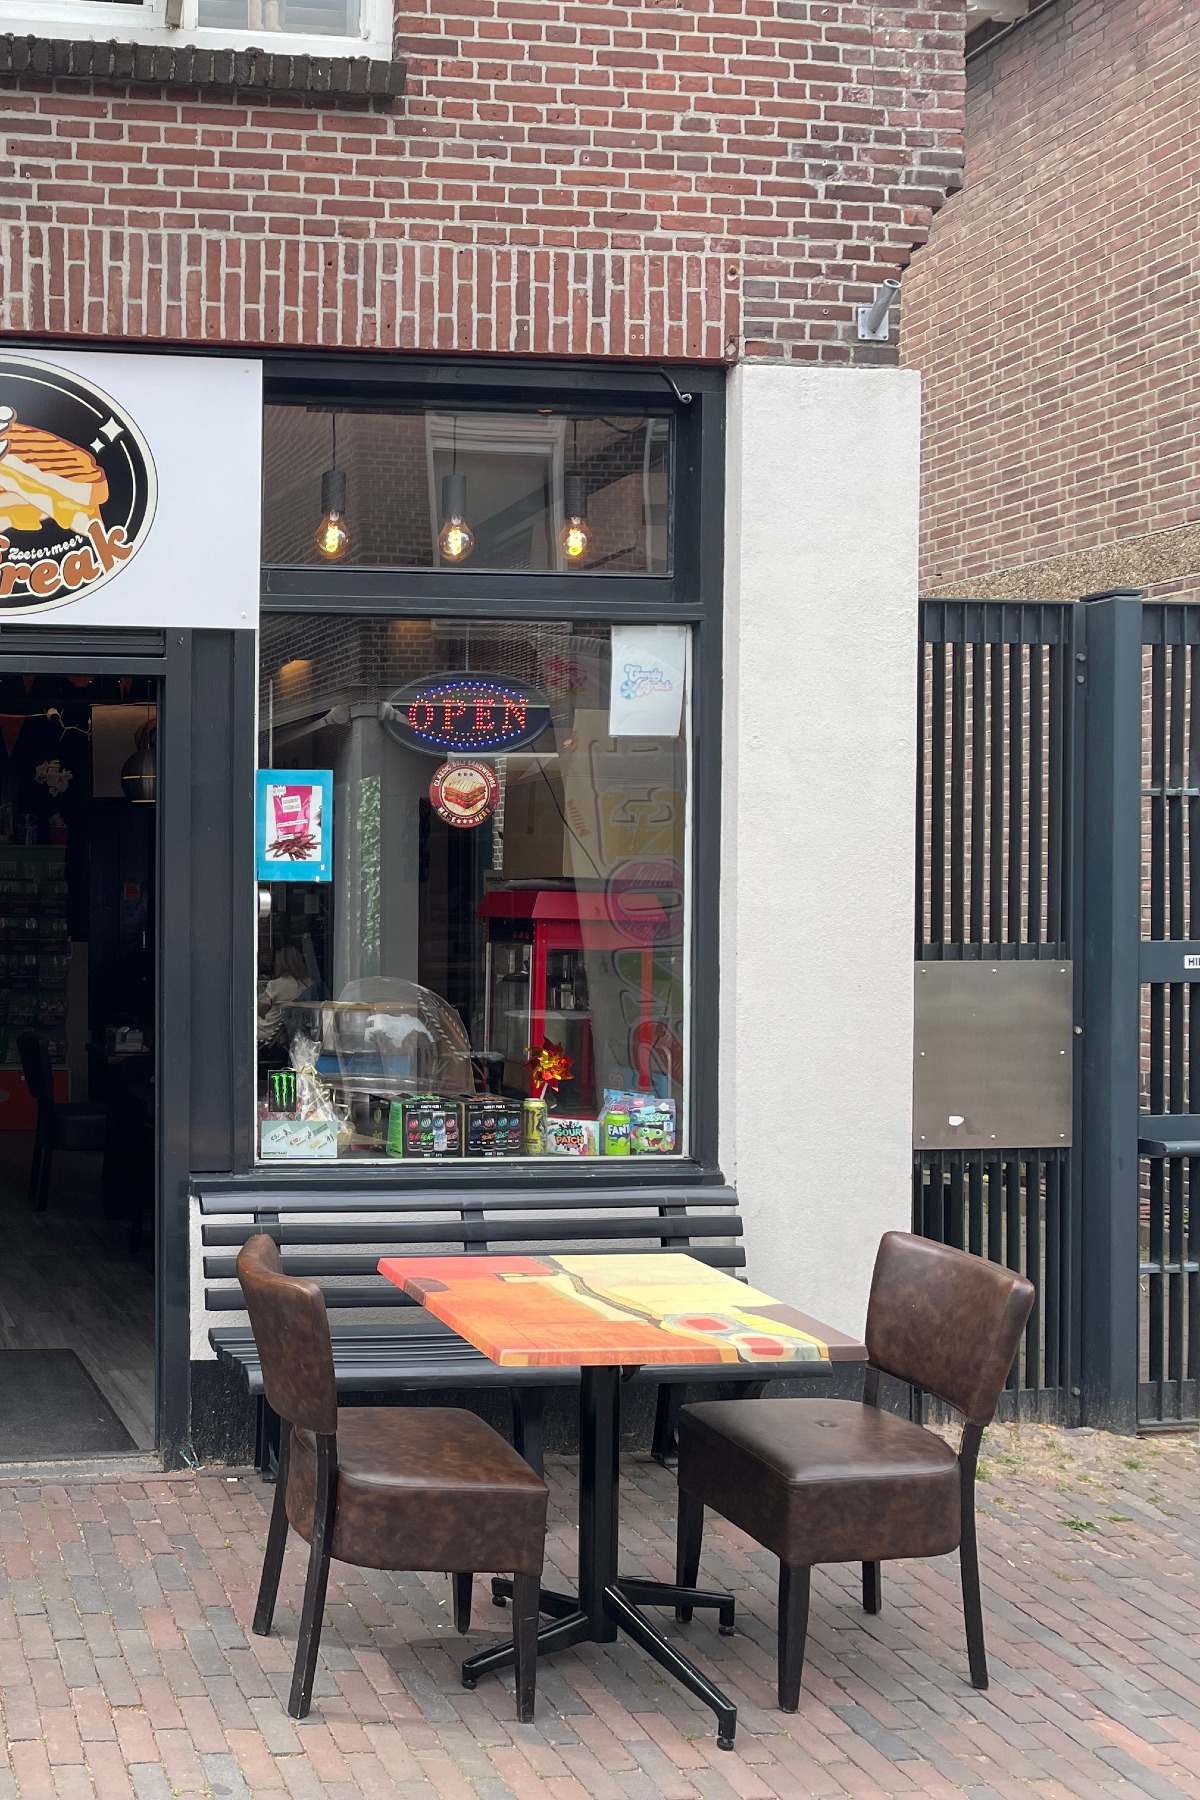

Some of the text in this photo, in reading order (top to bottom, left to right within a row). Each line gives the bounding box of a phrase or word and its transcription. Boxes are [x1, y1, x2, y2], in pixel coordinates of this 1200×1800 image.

[8, 535, 83, 560] Zoetermeer
[408, 697, 530, 732] OPEN
[556, 1136, 584, 1145] PATCH
